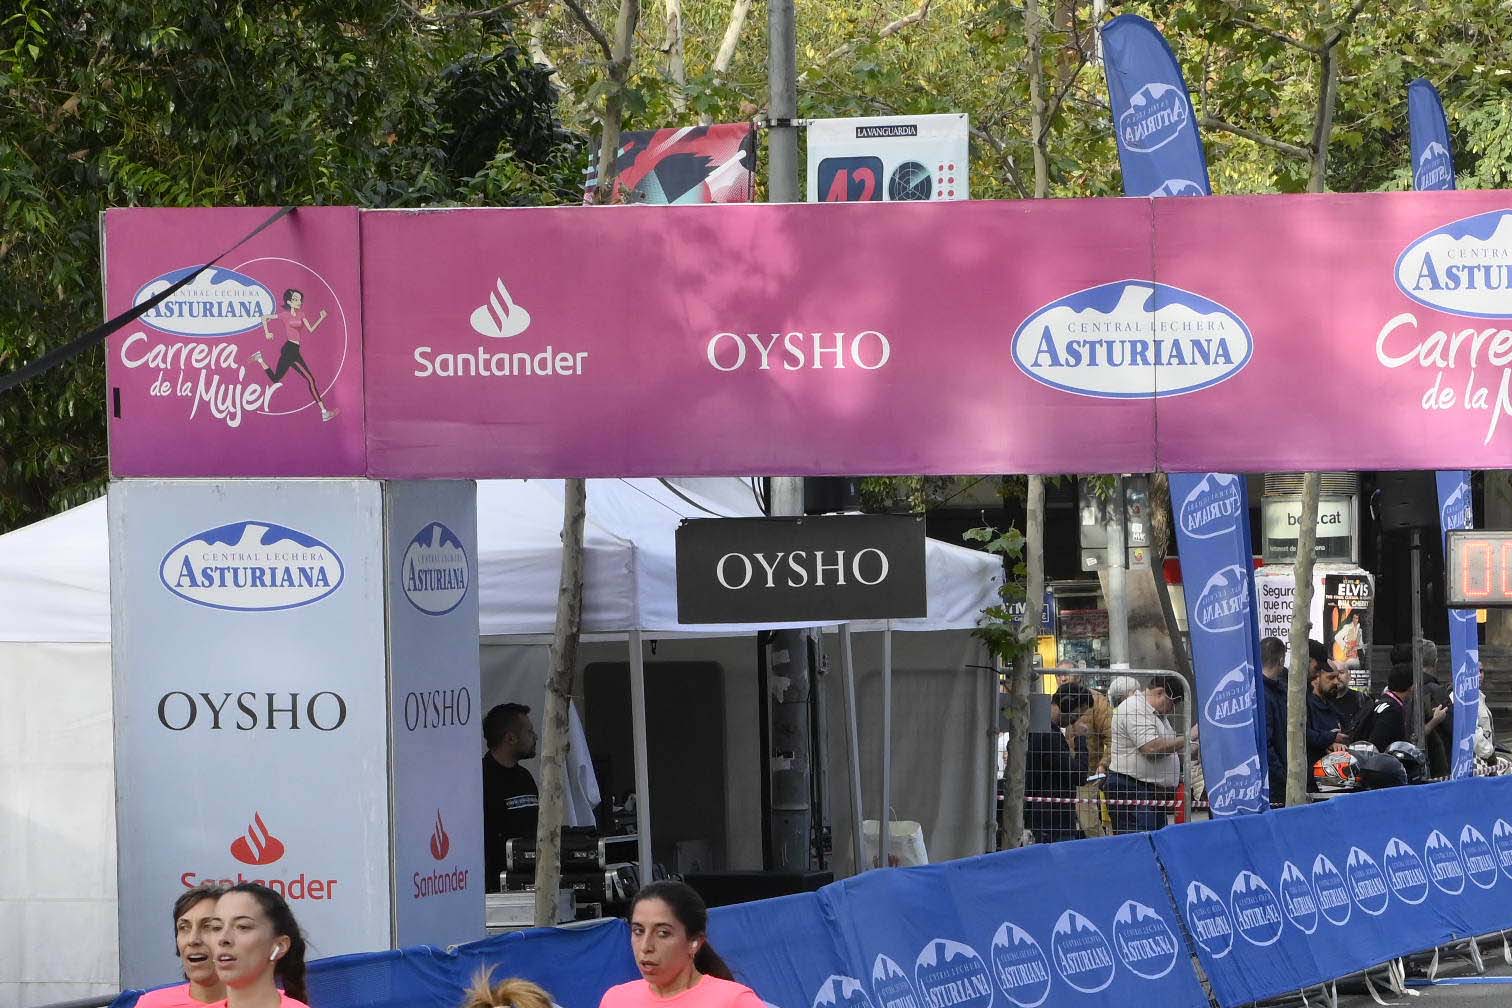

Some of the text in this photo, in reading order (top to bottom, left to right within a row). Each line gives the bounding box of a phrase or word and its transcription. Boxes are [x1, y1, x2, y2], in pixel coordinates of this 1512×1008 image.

[172, 288, 211, 298] ENTRAL
[1066, 319, 1226, 333] CENTRAL LECHERA
[119, 331, 240, 370] Carrera
[414, 345, 588, 378] Santander
[706, 331, 892, 372] OYSHO
[1030, 324, 1235, 368] ASTURIANA
[150, 366, 284, 428] de la Mujer
[1421, 372, 1457, 411] de
[1464, 367, 1489, 410] la
[174, 555, 331, 588] ASTURIANA
[202, 552, 324, 562] CENTRAL LECHERA
[407, 554, 465, 593] ASTURIANA
[716, 548, 889, 590] OYSHO
[1263, 600, 1280, 612] que
[1338, 583, 1369, 596] ELVIS
[156, 690, 348, 732] OYSHO
[404, 686, 471, 731] OYSHO
[413, 864, 469, 900] Santander
[996, 957, 1049, 990] ASTURIANA
[1057, 943, 1113, 976] ASTURIANA
